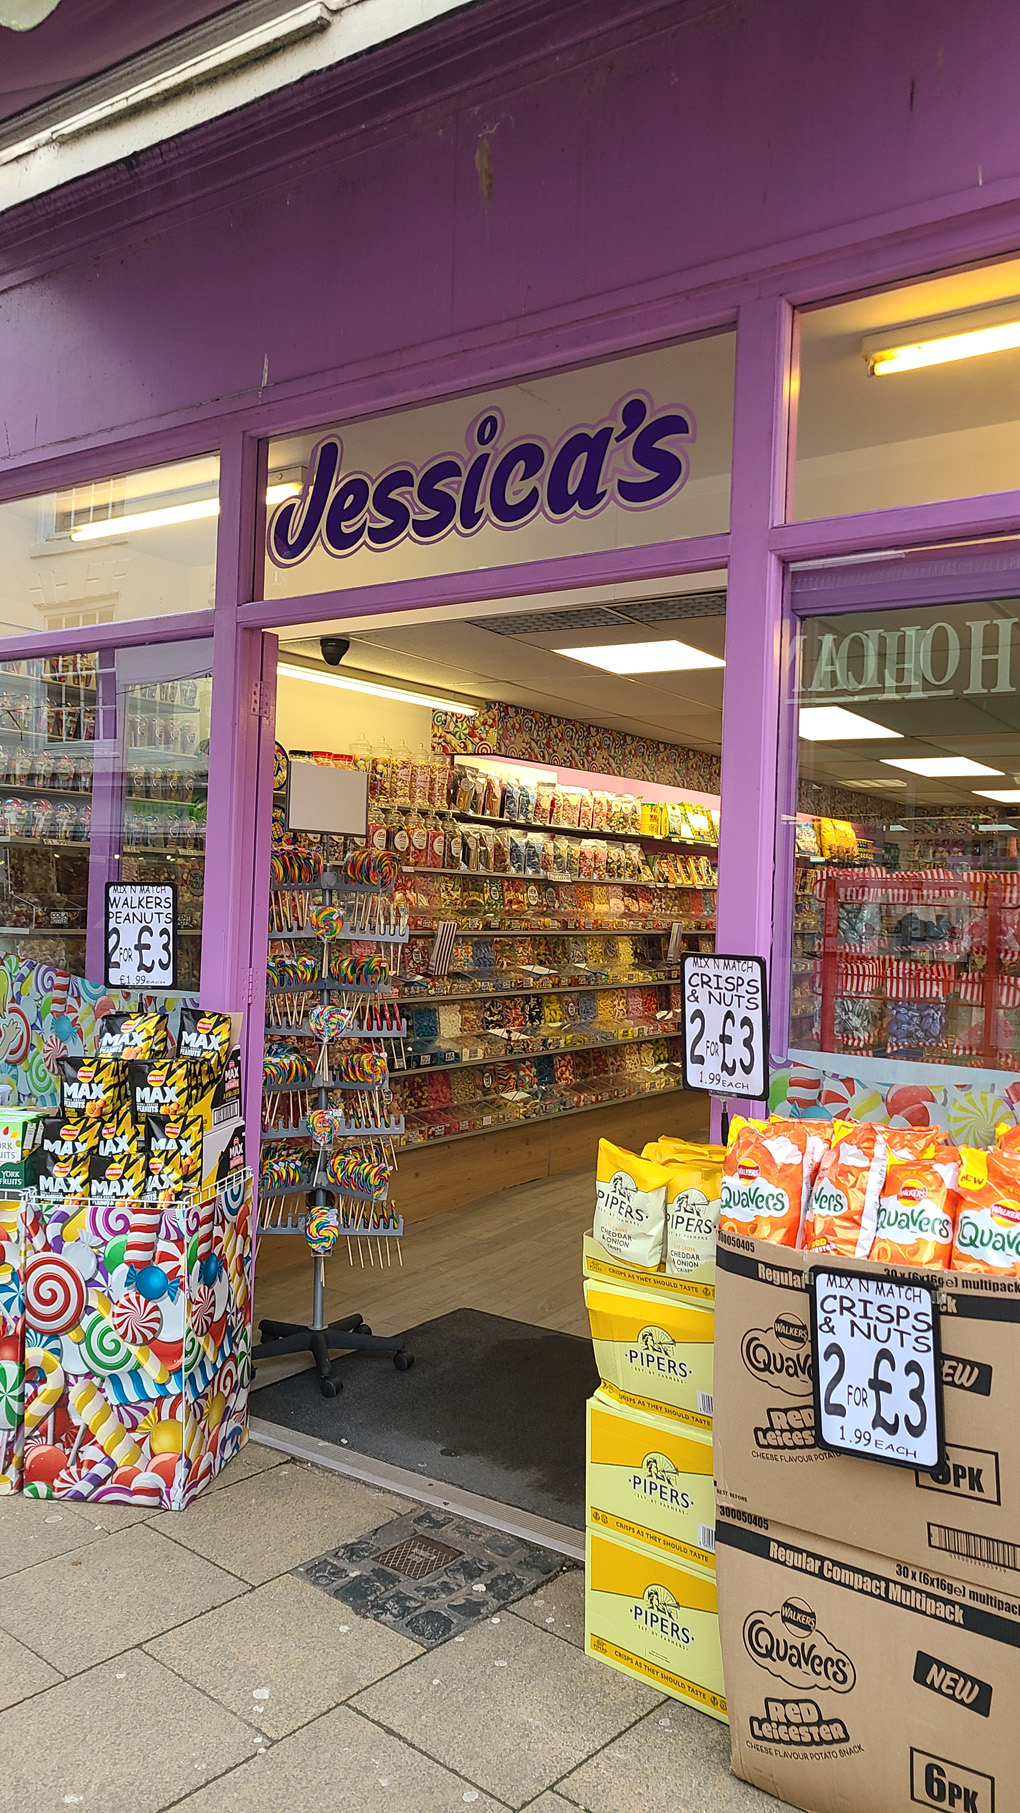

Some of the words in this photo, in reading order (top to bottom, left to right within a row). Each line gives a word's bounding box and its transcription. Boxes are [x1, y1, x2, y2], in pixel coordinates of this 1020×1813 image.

[268, 388, 697, 568] Jessica's
[109, 896, 172, 910] WALKERS
[109, 912, 172, 924] PEANUTS
[108, 926, 120, 970] 2
[120, 947, 133, 962] FOR
[134, 925, 172, 974] £3
[693, 958, 710, 970] MIX
[714, 958, 720, 970] N
[723, 960, 754, 974] MATCH
[120, 975, 146, 985] £1.99
[688, 972, 760, 995] CRISPS
[687, 988, 700, 1004] &
[708, 990, 760, 1010] NUTS
[102, 1032, 146, 1046] MAX
[182, 1030, 222, 1050] MAX
[690, 1008, 706, 1066] 2
[706, 1040, 720, 1057] FOR
[719, 1010, 755, 1076] £3
[224, 1066, 239, 1082] MAX
[699, 1070, 722, 1086] 1.99
[722, 1080, 749, 1090] EACH
[64, 1082, 106, 1100] MAX
[136, 1086, 179, 1104] MAX
[151, 1137, 192, 1156] MAX
[230, 1143, 243, 1158] MAX
[40, 1175, 83, 1192] MAX
[91, 1178, 135, 1196] MAX
[598, 1190, 644, 1222] PIPERS
[600, 1226, 632, 1242] CHEDDAR
[606, 1236, 630, 1248] ONION
[958, 1216, 1020, 1256] Quav
[670, 1250, 700, 1260] CHEDDAR
[676, 1260, 699, 1268] ONION
[608, 1267, 627, 1278] CRISPS
[652, 1278, 678, 1288] SHOULD
[679, 1284, 698, 1293] TASTE
[826, 1274, 853, 1291] MIX
[859, 1278, 870, 1294] N
[875, 1280, 922, 1304] MATCH
[820, 1294, 933, 1333] CRISPS
[775, 1322, 808, 1341] WALKERS
[819, 1316, 836, 1336] &
[850, 1320, 932, 1354] NUTS
[629, 1350, 688, 1378] PIPERS
[941, 1360, 979, 1388] EW
[824, 1342, 846, 1418] 2
[847, 1385, 868, 1408] FOR
[868, 1348, 928, 1438] £3
[646, 1402, 662, 1412] THEY
[664, 1407, 690, 1420] SHOULD
[691, 1416, 711, 1426] TASTE
[839, 1425, 872, 1448] 1.99
[874, 1439, 918, 1460] EACH
[752, 1450, 780, 1462] CHEESE
[780, 1454, 814, 1464] FLAVOUR
[633, 1474, 690, 1509] PIPERS
[730, 1492, 748, 1502] BEFORE
[720, 1506, 769, 1530] 300050405
[616, 1521, 636, 1534] CRISPS
[636, 1529, 644, 1537] AS
[646, 1532, 662, 1544] THEY
[662, 1540, 688, 1554] SHOULD
[690, 1550, 709, 1563] TASTE
[769, 1540, 821, 1575] Regular
[823, 1560, 886, 1598] Compact
[888, 1582, 965, 1626] Multipack
[896, 1564, 909, 1580] 30
[911, 1570, 918, 1582] x
[634, 1605, 690, 1645] PIPERS
[782, 1606, 816, 1629] WALKERS
[614, 1650, 634, 1664] CRISPS
[634, 1661, 642, 1669] AS
[644, 1664, 660, 1677] THEY
[660, 1672, 686, 1690] SHOULD
[686, 1685, 706, 1700] TASTE
[926, 1663, 980, 1704] NEW
[746, 1740, 774, 1756] CHEESE
[774, 1748, 810, 1760] FLAVOUR
[810, 1750, 838, 1760] POTATO
[838, 1744, 864, 1758] SNACK
[924, 1762, 978, 1813] 6PK
